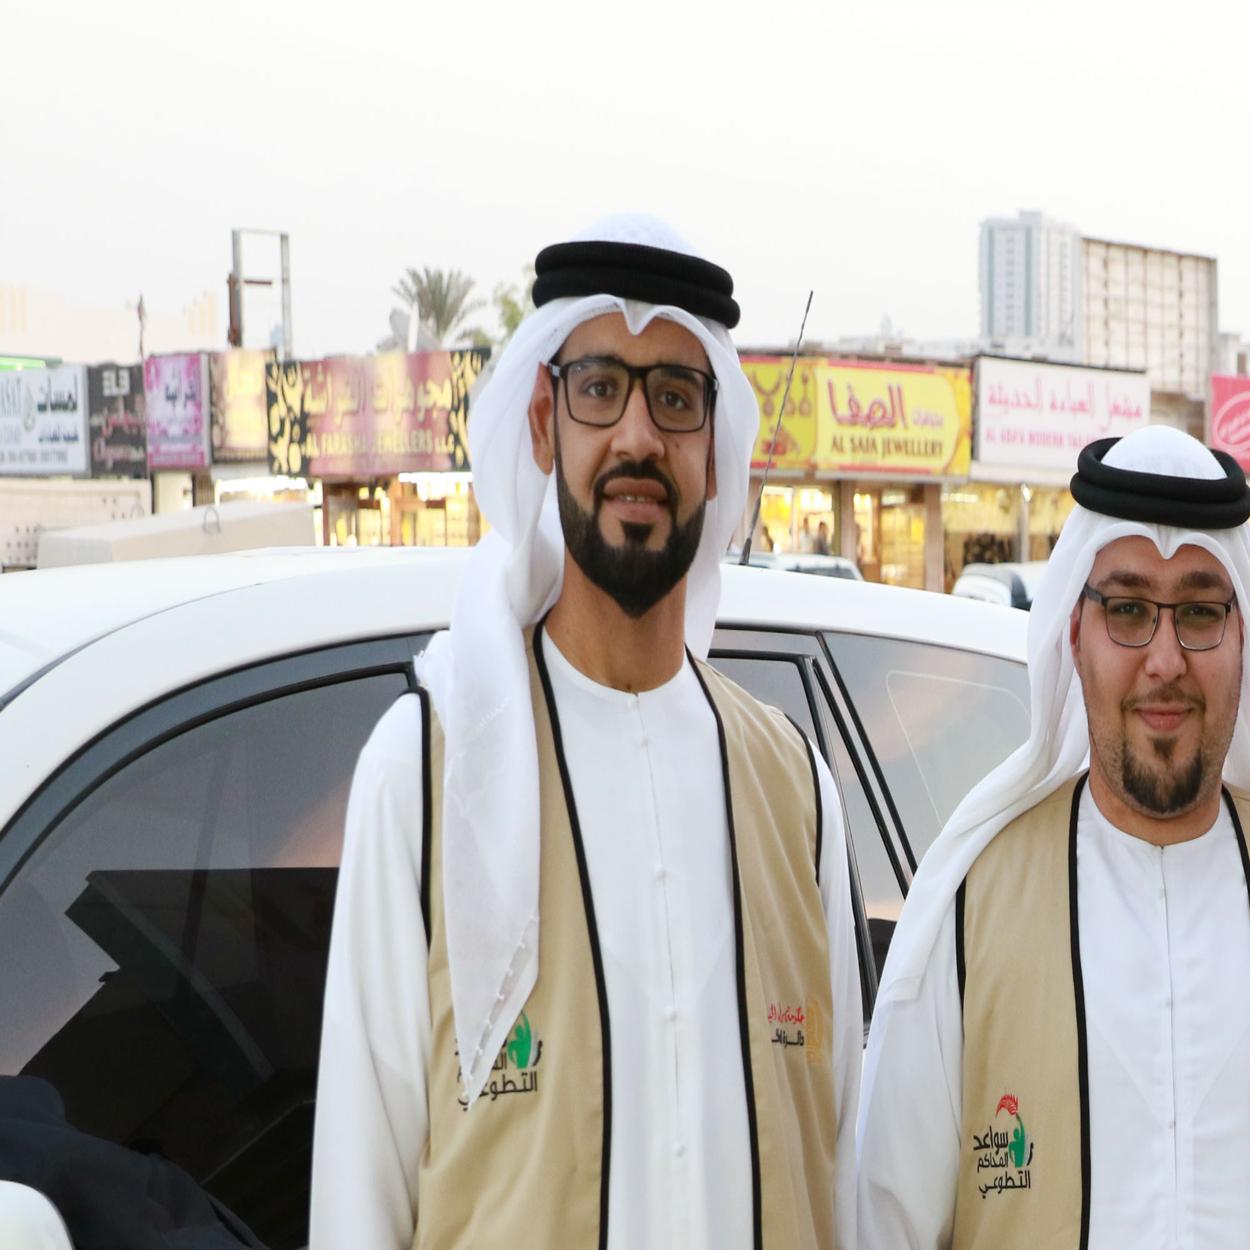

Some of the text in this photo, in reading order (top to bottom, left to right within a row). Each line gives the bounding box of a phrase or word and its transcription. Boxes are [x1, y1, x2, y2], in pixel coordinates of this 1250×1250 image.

[827, 379, 908, 431] الصفا
[832, 435, 943, 459] AL SAFA JEWELLERY
[973, 1125, 1008, 1155] سواعد
[977, 1151, 1008, 1173] المحاكم
[978, 1170, 1031, 1199] التطوعي
